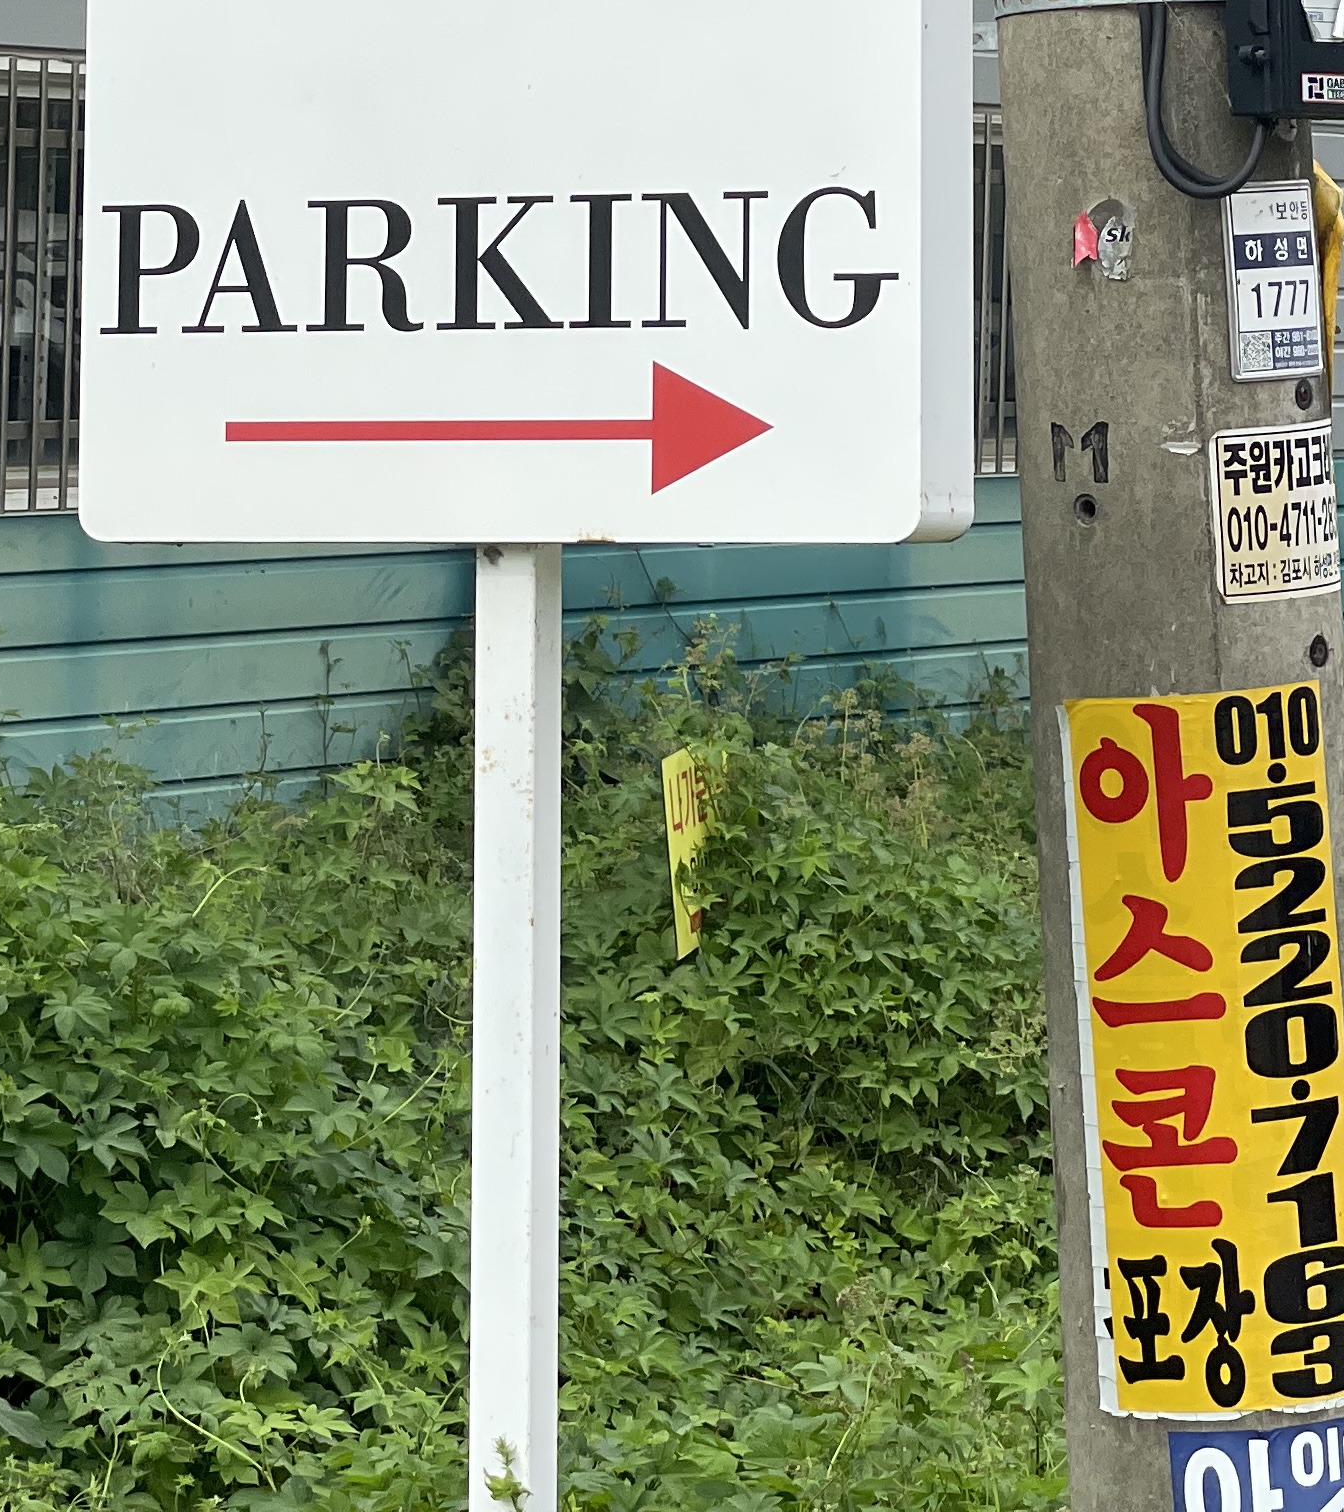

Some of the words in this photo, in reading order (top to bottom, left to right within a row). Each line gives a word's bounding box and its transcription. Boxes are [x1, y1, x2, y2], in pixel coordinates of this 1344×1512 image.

[99, 186, 900, 336] PARKING
[1250, 279, 1309, 319] 1777
[1116, 1237, 1256, 1409] 포장
